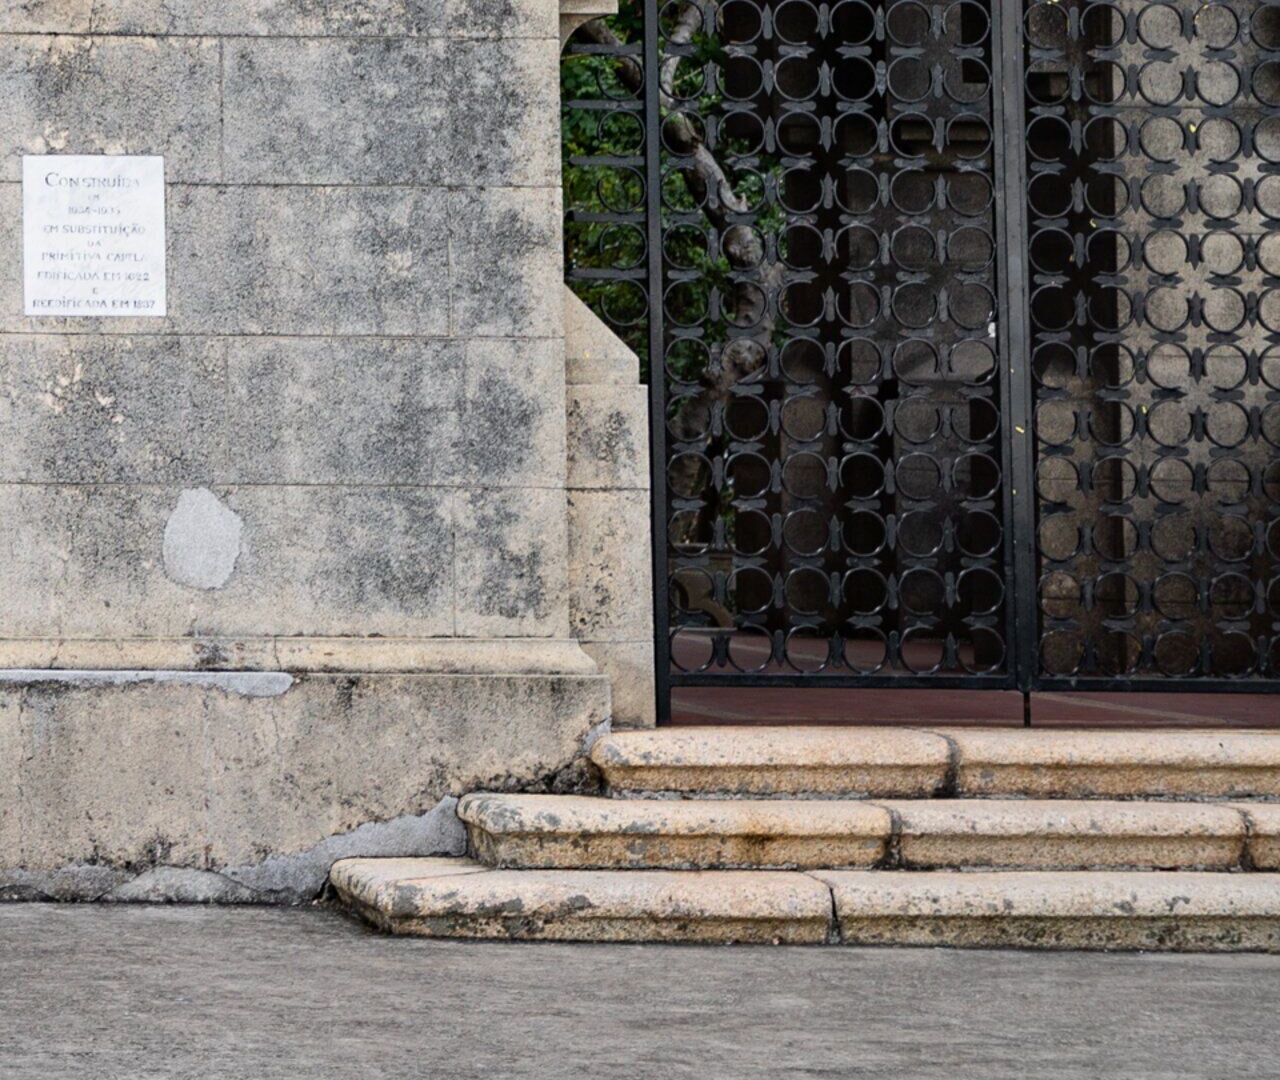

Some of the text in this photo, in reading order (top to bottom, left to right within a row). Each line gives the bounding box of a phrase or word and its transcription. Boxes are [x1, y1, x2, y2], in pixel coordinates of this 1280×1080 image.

[43, 224, 59, 234] EM
[103, 272, 121, 281] EM
[111, 299, 130, 309] EM
